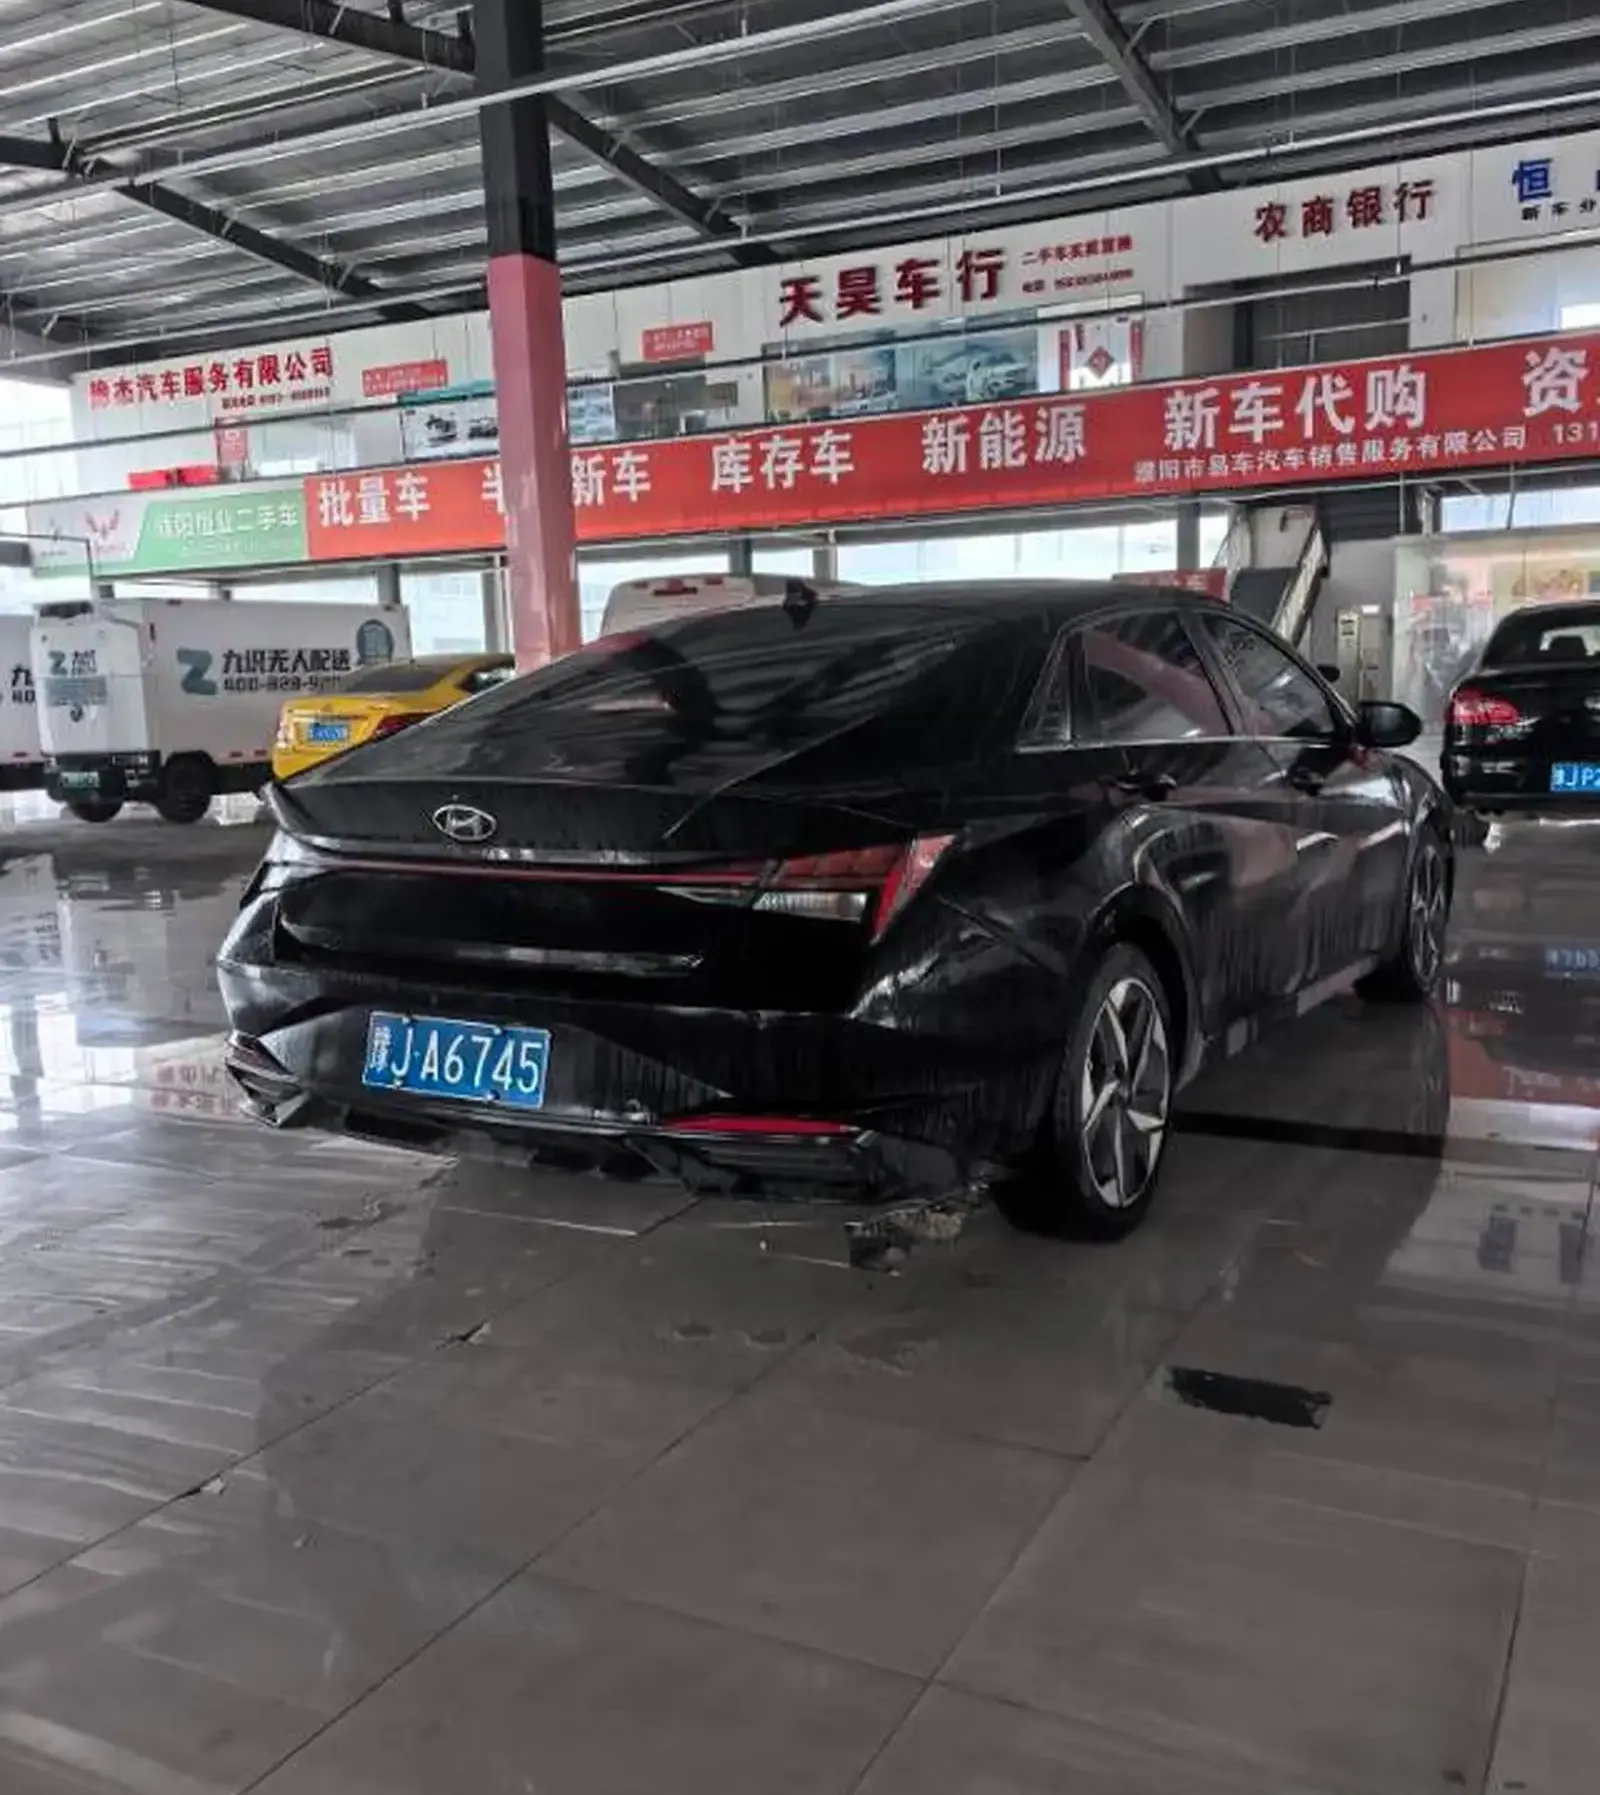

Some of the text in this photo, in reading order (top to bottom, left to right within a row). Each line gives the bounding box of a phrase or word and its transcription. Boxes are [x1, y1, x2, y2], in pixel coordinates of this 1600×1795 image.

[1254, 180, 1434, 242] 农商银行
[779, 248, 1005, 328] 天昊车行
[318, 472, 431, 528] 批量车
[711, 428, 855, 494] 库存车
[921, 404, 1088, 475] 新能源
[1164, 364, 1428, 452] 新车代购
[1522, 346, 1600, 418] 资
[223, 648, 351, 674] 九识无人配送
